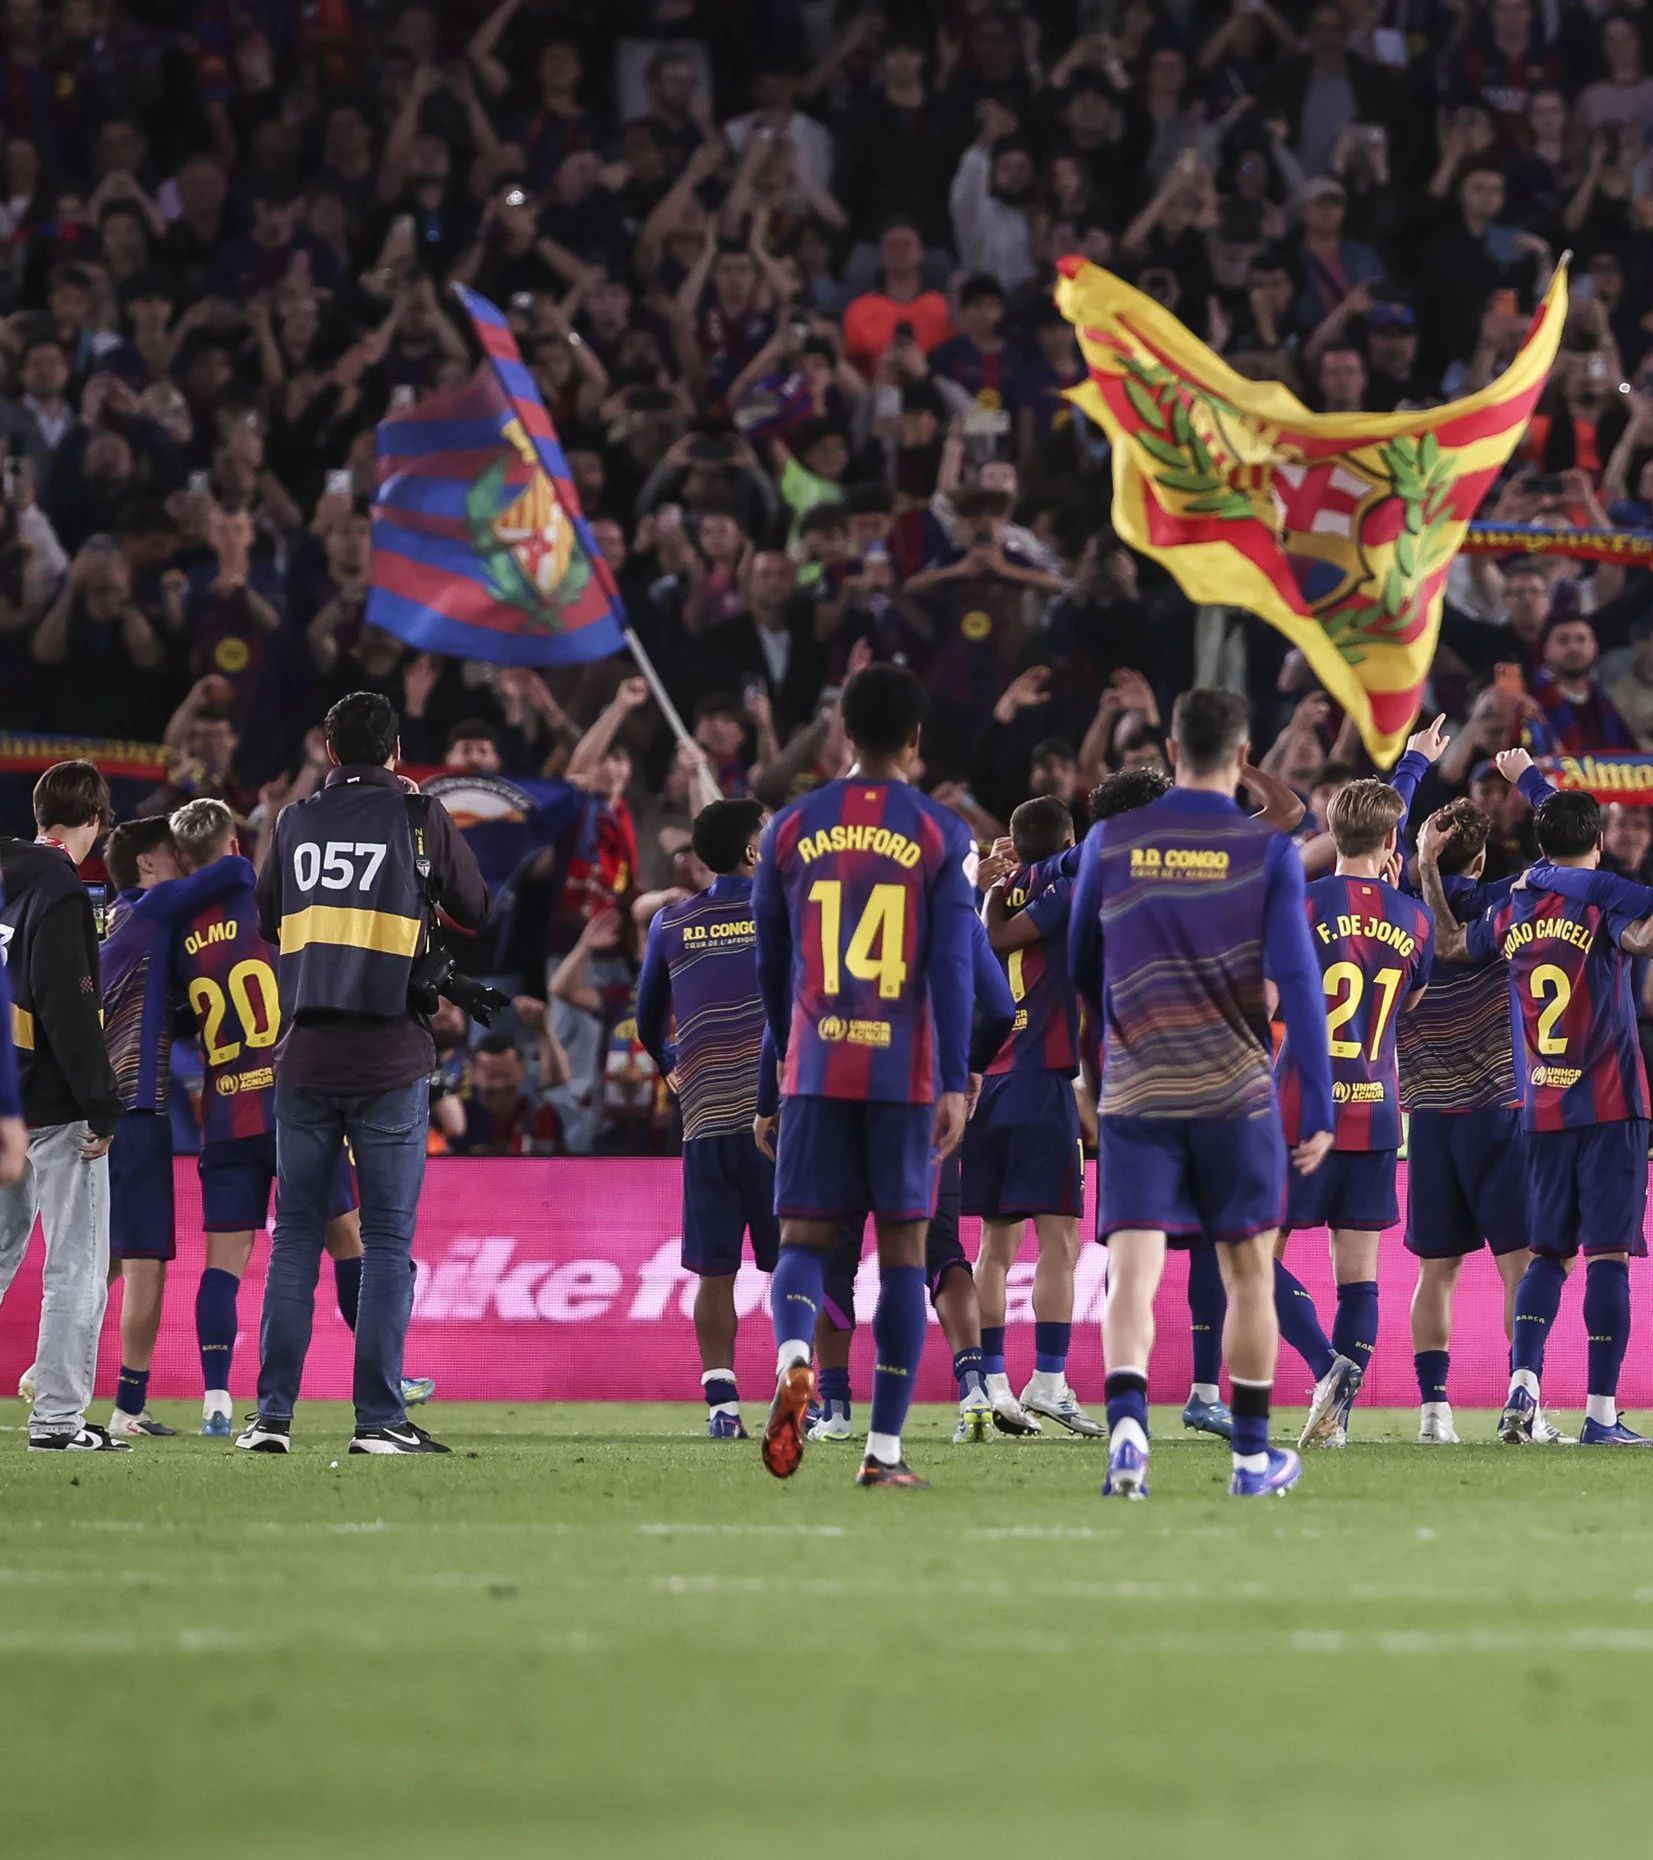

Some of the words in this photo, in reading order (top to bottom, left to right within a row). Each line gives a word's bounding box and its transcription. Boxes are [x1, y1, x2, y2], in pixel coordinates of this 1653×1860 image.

[293, 841, 388, 892] 057
[798, 825, 922, 869] RASHFORD
[1164, 849, 1230, 869] CONGO
[185, 920, 238, 957] OLMO
[682, 925, 708, 941] R.D.
[807, 879, 907, 1000] 14
[1316, 922, 1338, 945] F.
[1336, 914, 1362, 938] DE
[1363, 916, 1416, 958] JONG
[1503, 922, 1534, 961] JOÃO
[188, 958, 282, 1067] 20
[1322, 960, 1403, 1062] 21
[1530, 962, 1572, 1055] 2
[239, 1066, 273, 1082] UNHCR
[1352, 1082, 1383, 1092] UNHCR
[1547, 1066, 1582, 1077] UNHCR
[1351, 1089, 1384, 1100] ACNUR
